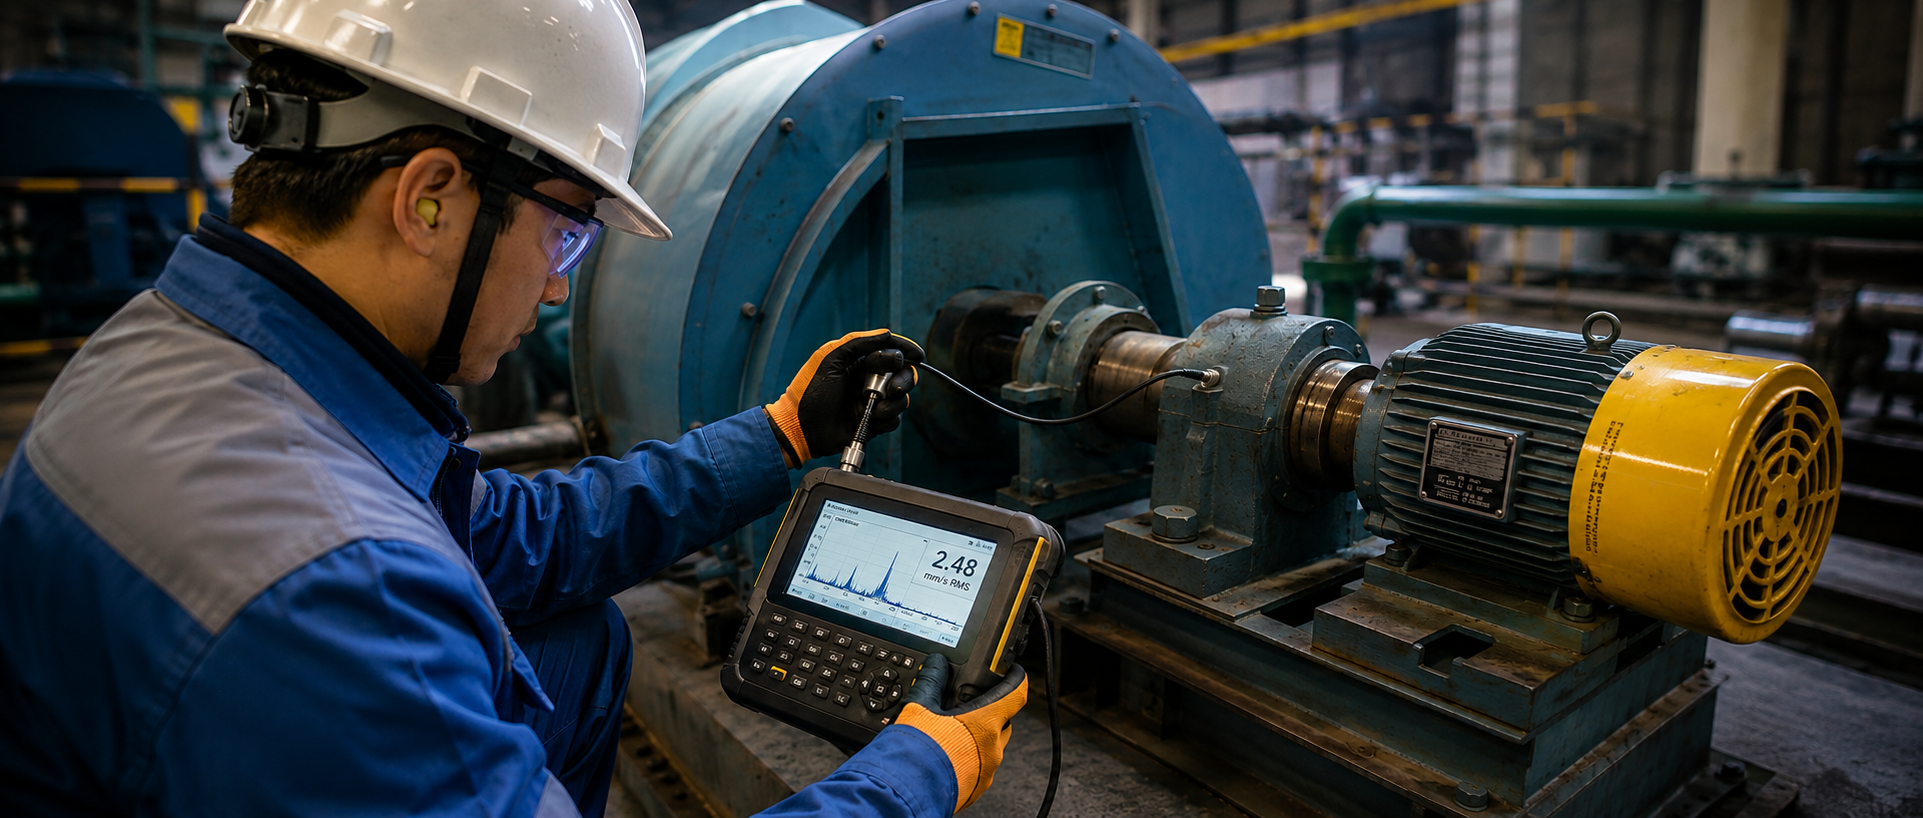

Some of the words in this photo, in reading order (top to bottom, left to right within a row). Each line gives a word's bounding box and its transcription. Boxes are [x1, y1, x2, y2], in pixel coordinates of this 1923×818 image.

[931, 550, 978, 577] 2.48
[923, 572, 949, 586] mm/s
[949, 578, 971, 592] RMS
